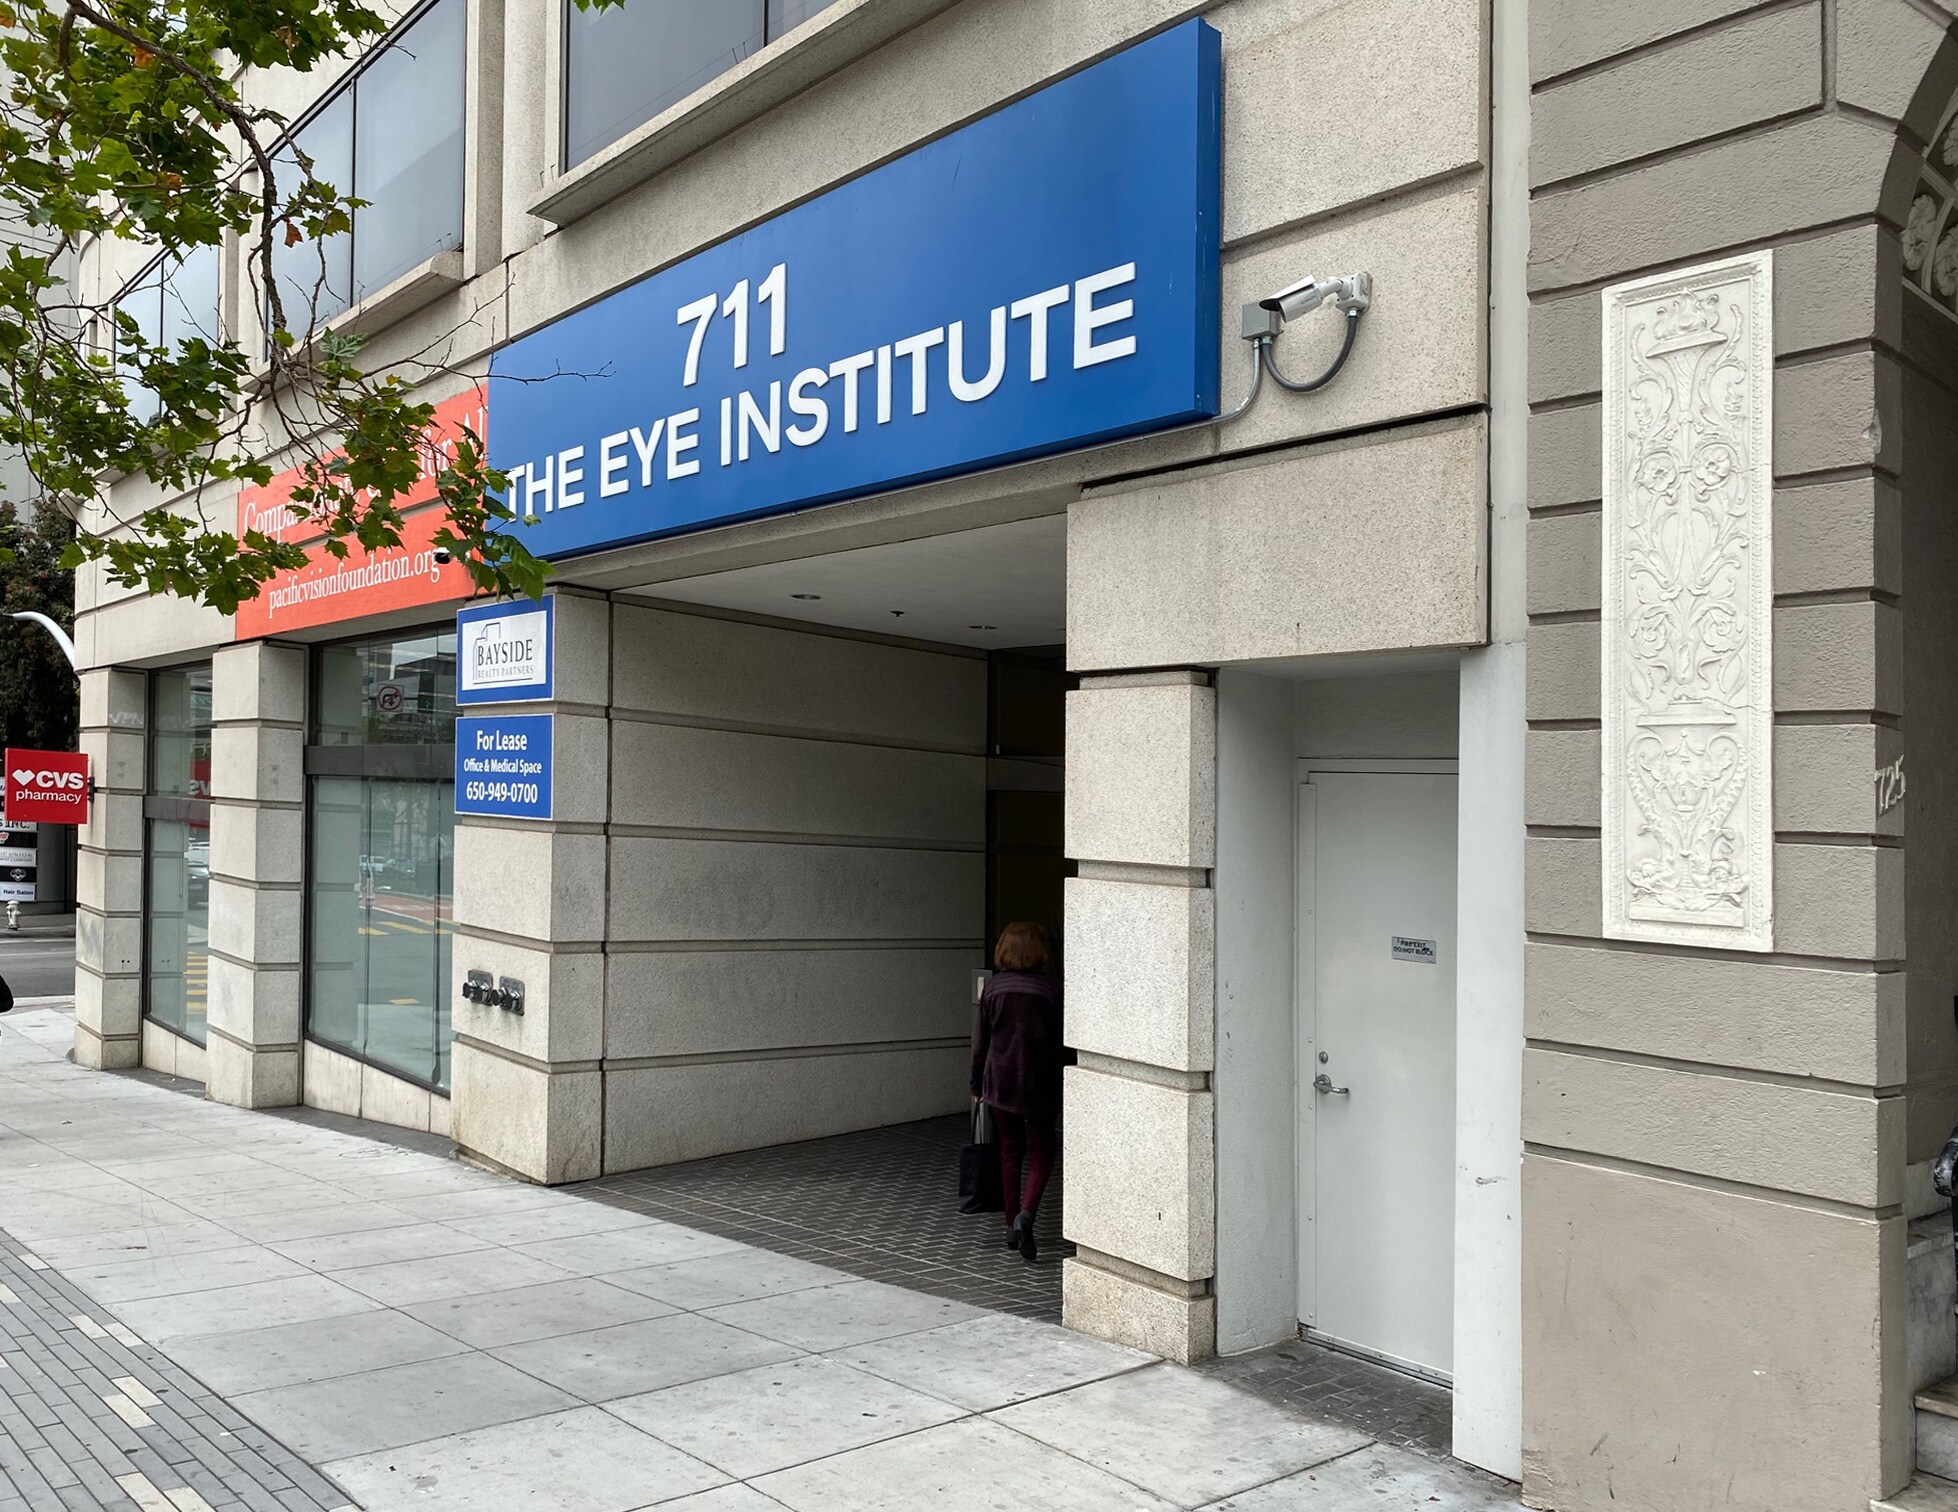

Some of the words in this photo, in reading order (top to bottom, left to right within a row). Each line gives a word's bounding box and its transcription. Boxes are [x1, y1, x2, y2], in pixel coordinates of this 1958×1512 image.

[676, 262, 788, 387] 711
[505, 445, 585, 523] THE
[600, 407, 700, 498] EYE
[720, 261, 1137, 466] INSTITUTE
[269, 548, 441, 619] pacificvisionfoundation.org
[477, 639, 533, 667] BAYSIDE
[477, 668, 500, 679] REALTY
[501, 664, 534, 677] PARTNERS
[476, 730, 494, 751] For
[495, 729, 527, 751] Lease
[463, 758, 483, 773] Office
[484, 758, 490, 773] &
[490, 758, 518, 774] Medical
[519, 759, 542, 777] Space
[36, 770, 84, 790] CVS
[15, 788, 82, 805] pharmacy
[466, 781, 539, 804] 650-949-0700
[1415, 948, 1434, 956] BLOCK
